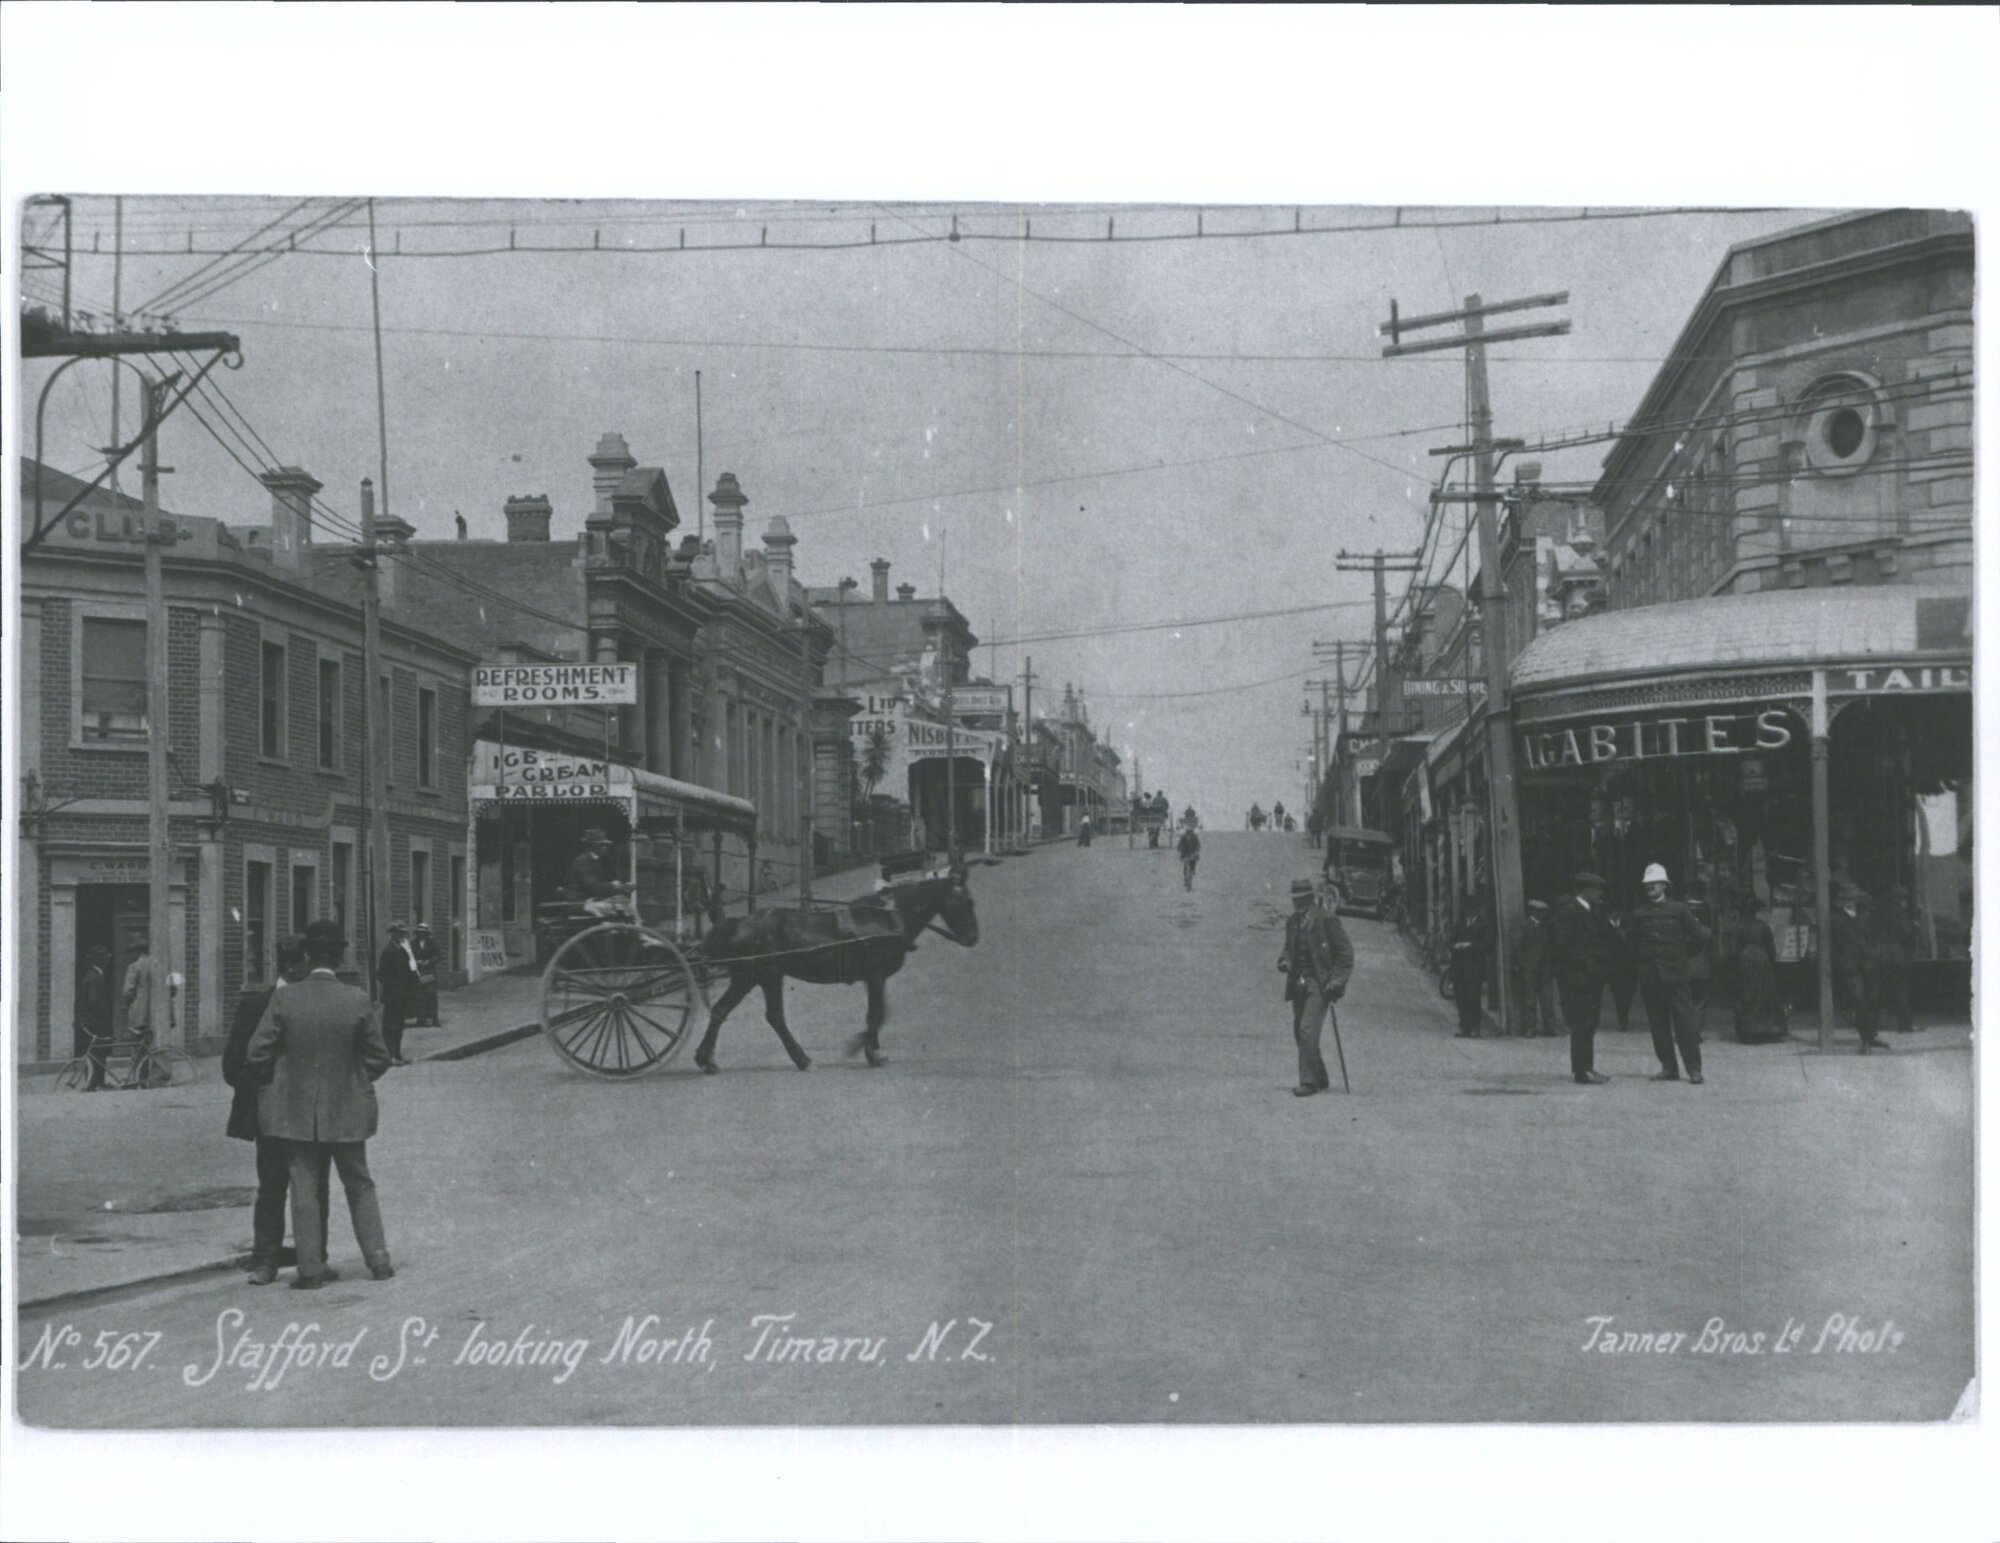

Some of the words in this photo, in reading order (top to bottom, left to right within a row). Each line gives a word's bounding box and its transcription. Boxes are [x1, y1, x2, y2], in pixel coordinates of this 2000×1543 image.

[66, 510, 177, 547] CLUB
[476, 667, 629, 686] REFRESHMENT
[1403, 680, 1440, 695] DINING
[908, 724, 961, 744] NISBT
[493, 751, 538, 769] ICE
[914, 748, 977, 757] PLUMERS
[522, 764, 608, 782] CREAM
[495, 784, 607, 797] PARLOR
